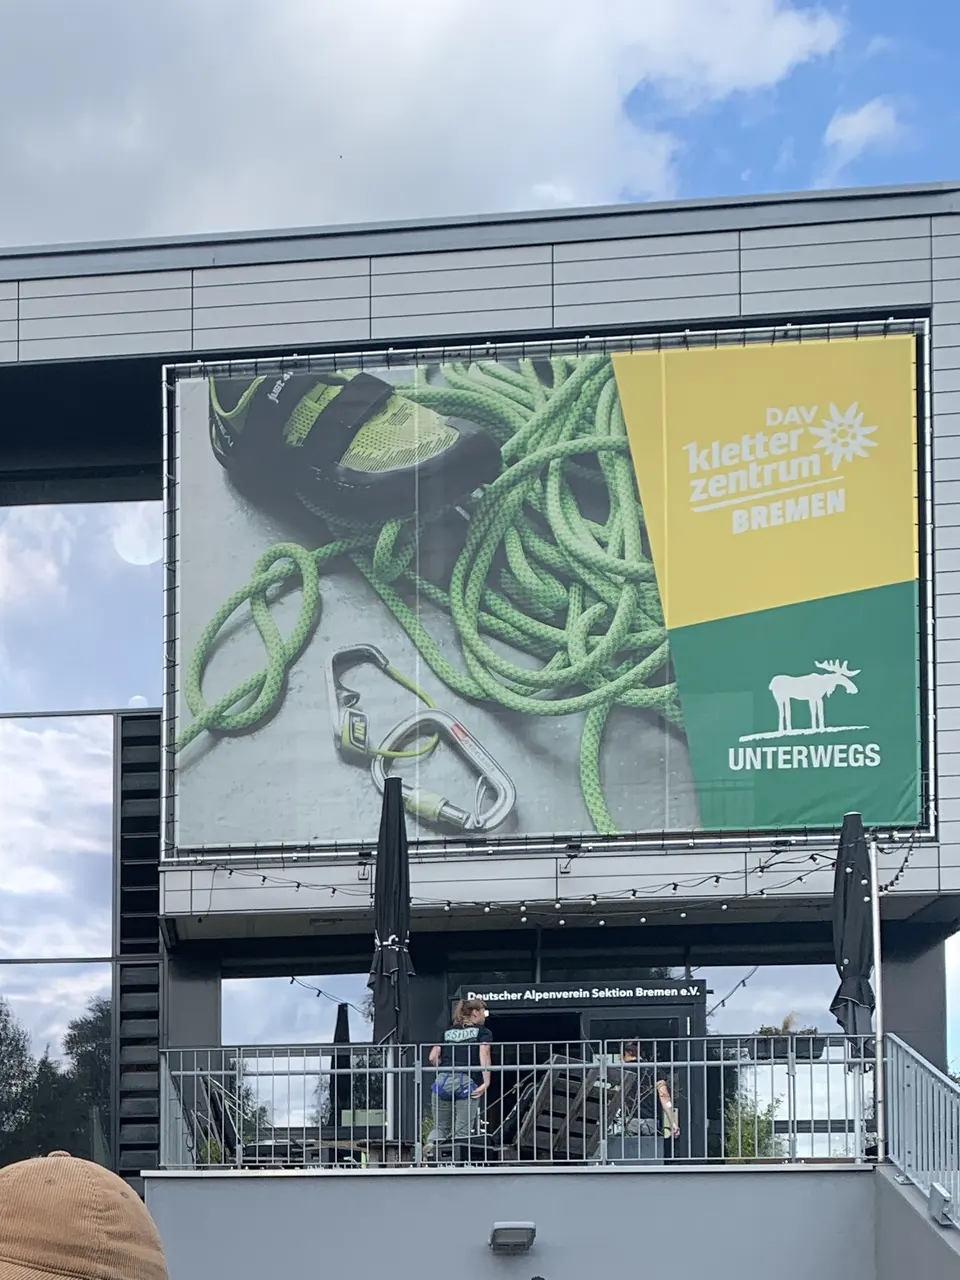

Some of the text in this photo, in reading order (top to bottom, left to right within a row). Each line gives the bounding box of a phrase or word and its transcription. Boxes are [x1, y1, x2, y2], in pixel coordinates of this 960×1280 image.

[766, 405, 819, 427] DAV
[682, 428, 804, 474] kletter
[689, 453, 821, 503] zentrum
[732, 488, 846, 535] BREMEN
[728, 743, 881, 771] UNTERWEGS
[467, 986, 701, 1002] Deutscher Alpenverein Sektion Bremen e.V.
